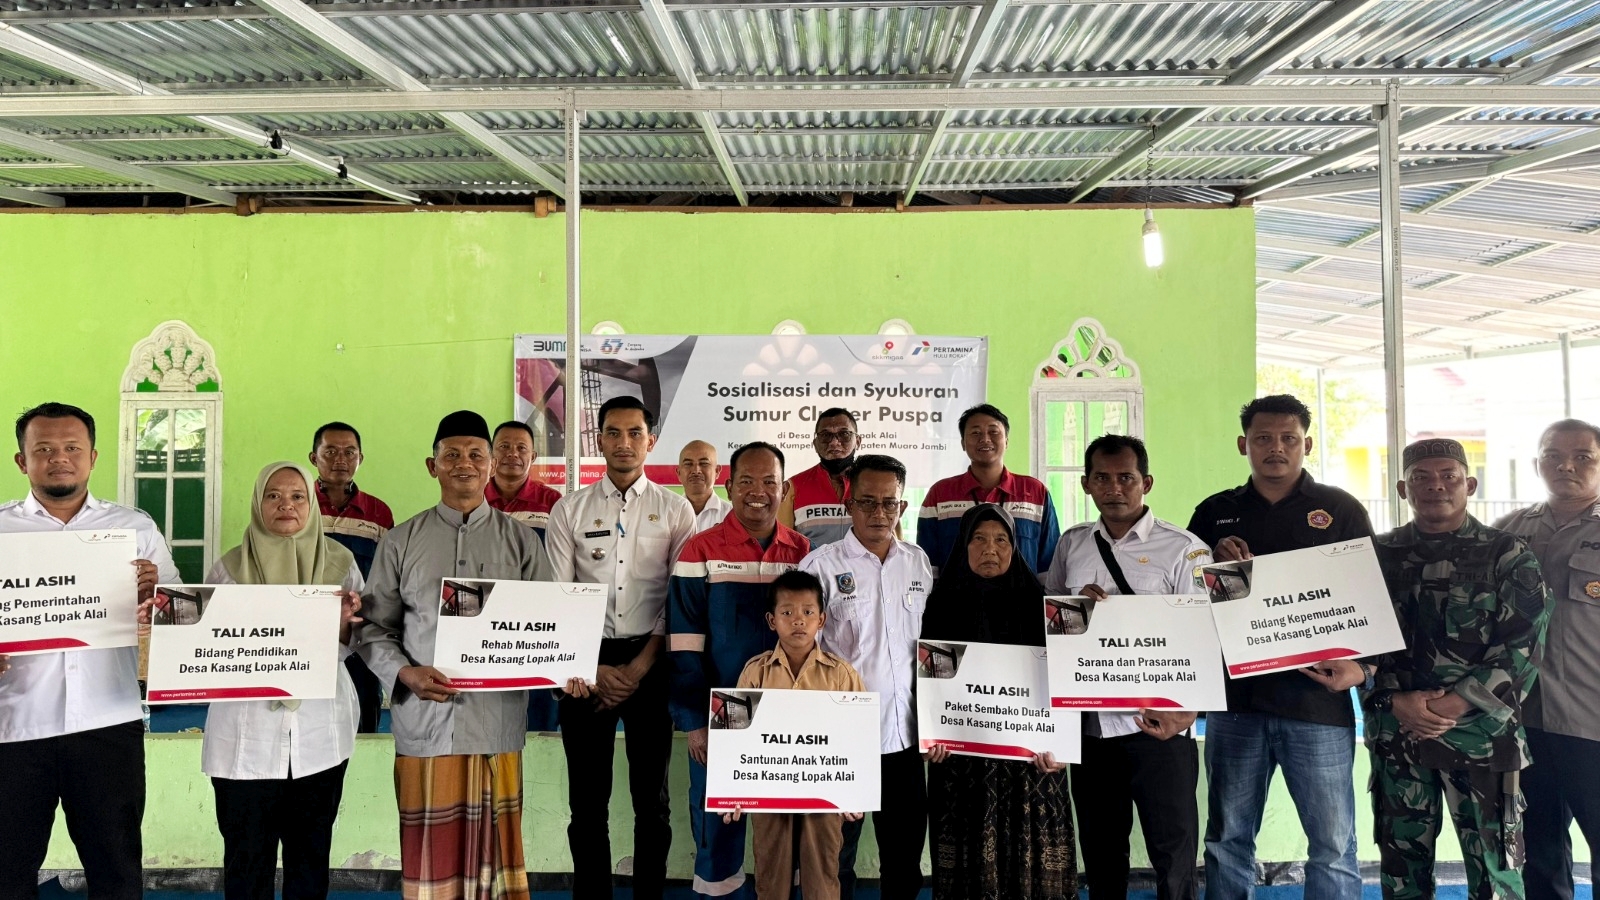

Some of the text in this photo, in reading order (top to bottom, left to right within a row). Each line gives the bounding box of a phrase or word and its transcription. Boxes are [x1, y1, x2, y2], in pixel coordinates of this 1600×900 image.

[534, 341, 566, 352] BUM
[707, 382, 959, 401] Sosialisasi dan Syukuran
[723, 405, 942, 426] Sumur Cler Puspa
[777, 431, 811, 439] di Desa
[879, 431, 897, 439] Alai
[780, 442, 814, 450] Kumpe
[861, 442, 886, 450] paten
[921, 443, 947, 451] Jambi
[806, 507, 847, 518] PERTA
[0, 575, 76, 589] ALI ASIH
[14, 595, 101, 609] Pemerintahan
[1263, 588, 1331, 608] TALI ASIH
[44, 611, 81, 624] Lopak
[84, 608, 107, 619] Alai
[1250, 604, 1356, 630] Bidang Kepemudaan
[212, 627, 285, 638] TALI ASIH
[491, 621, 556, 632] TALI ASIH
[1246, 616, 1369, 646] Desa Kasang Lopak Alai
[481, 639, 560, 650] Rehab Musholla
[1099, 637, 1167, 648] TALI ASIH
[194, 647, 298, 659] Bidang Pendidikan
[460, 652, 576, 665] Desa Kasang Lopak Alai
[179, 660, 310, 674] Desa Kasang Lopak Alai
[1077, 657, 1191, 667] Sarana dan Prasarana
[1074, 671, 1196, 683] Desa Kasang Lopak Alai
[965, 683, 1030, 698] TALI ASIH
[944, 701, 1050, 718] Paket Sembako Duafa
[940, 715, 1055, 733] Desa Kasang Lopak Alai
[761, 733, 829, 745] TALI ASIH
[740, 754, 848, 766] Santunan Anak Yatim
[733, 770, 855, 783] Desa Kasang Lopak Alai
